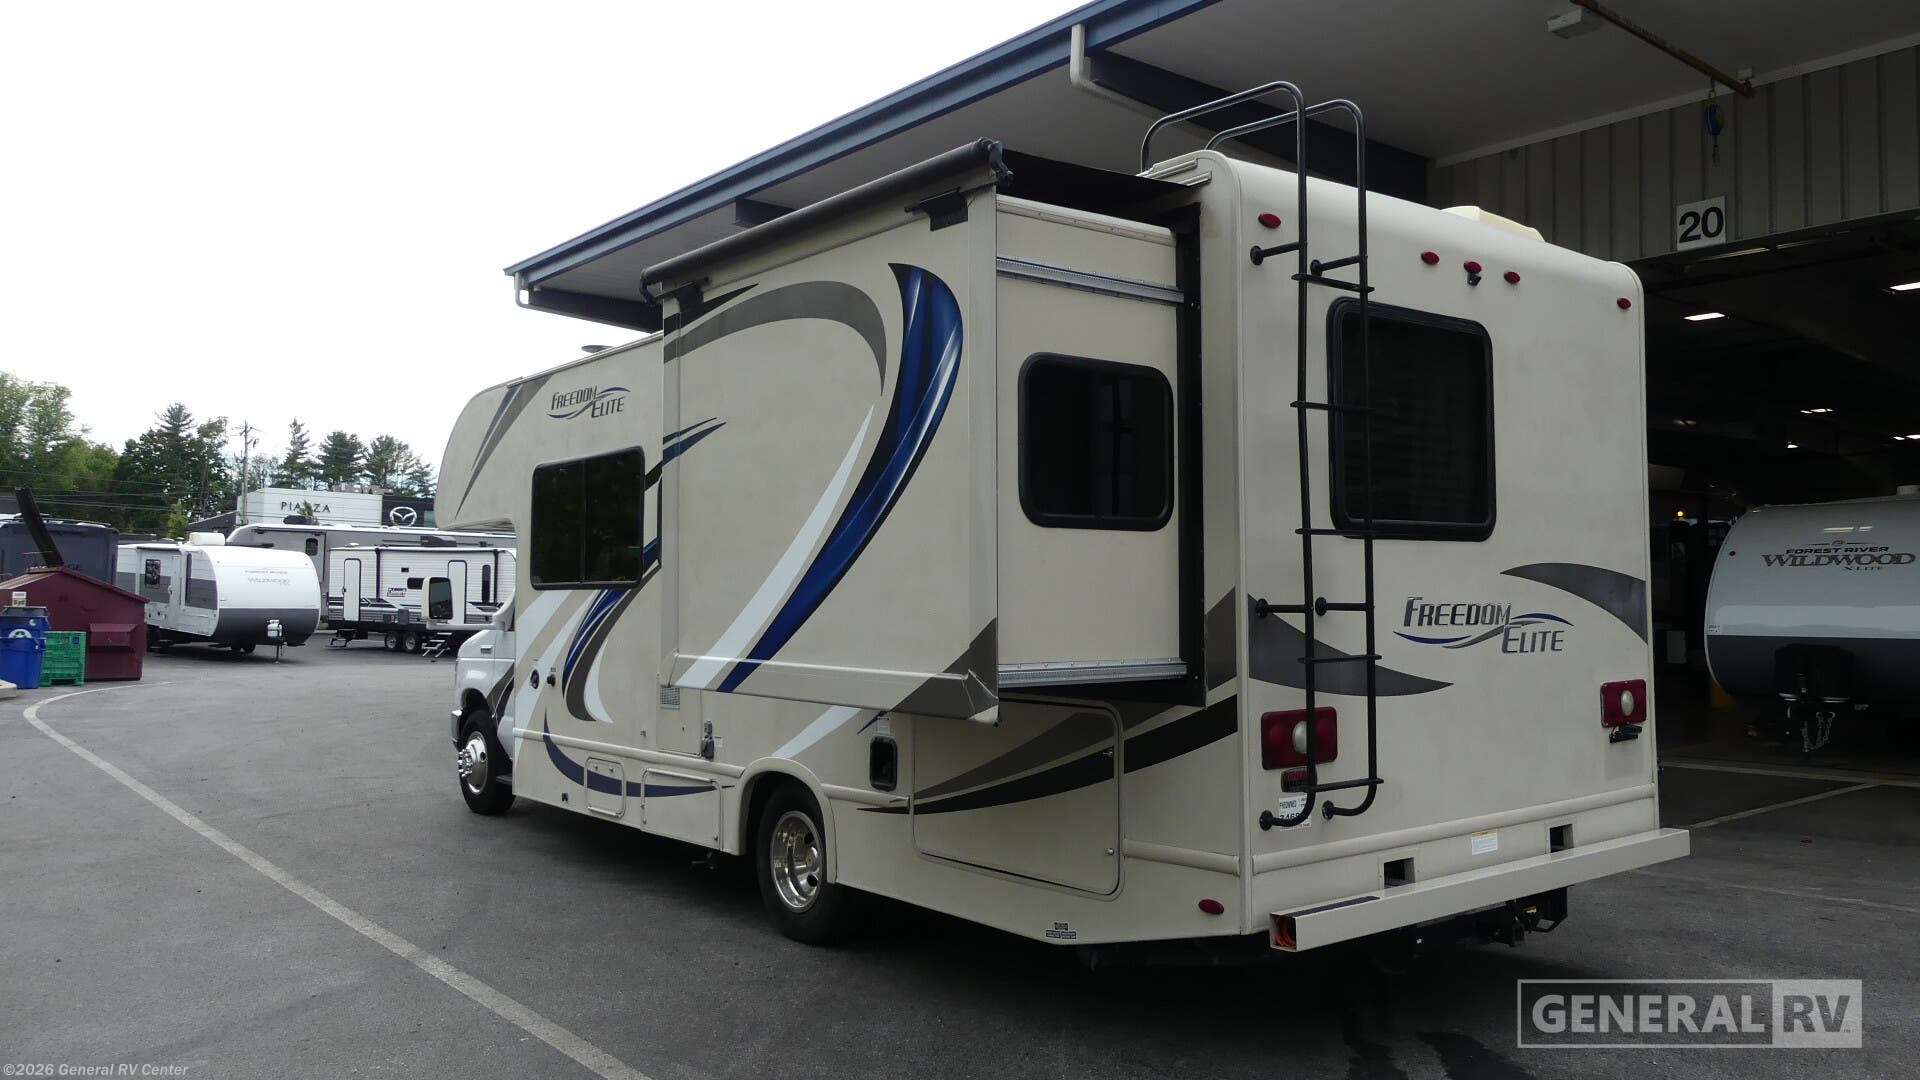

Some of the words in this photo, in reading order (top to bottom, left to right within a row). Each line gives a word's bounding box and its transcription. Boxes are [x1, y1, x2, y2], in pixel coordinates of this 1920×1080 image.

[1679, 206, 1724, 243] 20
[551, 385, 598, 410] FREEDOM
[591, 397, 625, 418] ELITE
[281, 501, 330, 513] PIAZA
[1762, 553, 1916, 567] WILDWOOD
[1403, 596, 1512, 627] FREEDOM
[1501, 625, 1565, 654] ELITE
